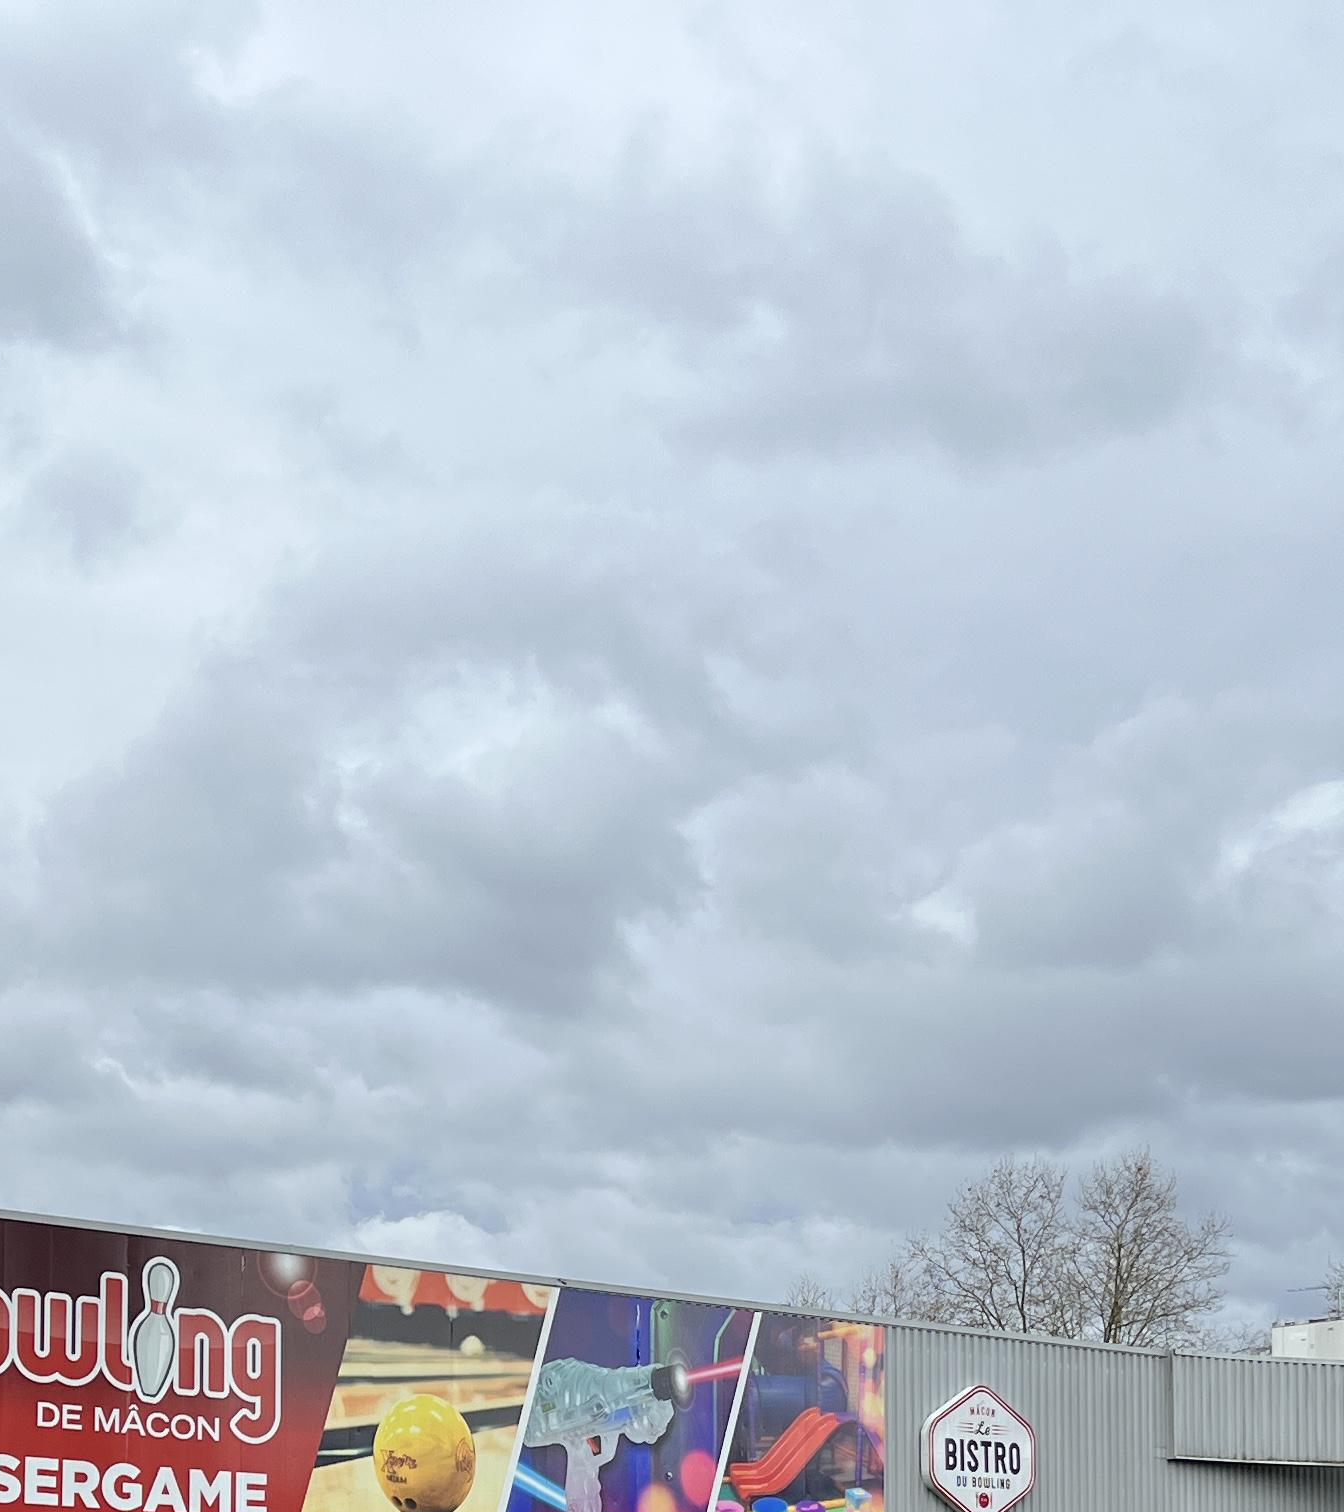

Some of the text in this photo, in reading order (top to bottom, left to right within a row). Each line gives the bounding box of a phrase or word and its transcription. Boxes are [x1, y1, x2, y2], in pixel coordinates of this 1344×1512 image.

[36, 1401, 220, 1442] DE MÂCON
[974, 1420, 991, 1436] Le
[944, 1437, 1021, 1476] BISTRO
[956, 1475, 1011, 1490] DU BOWLING
